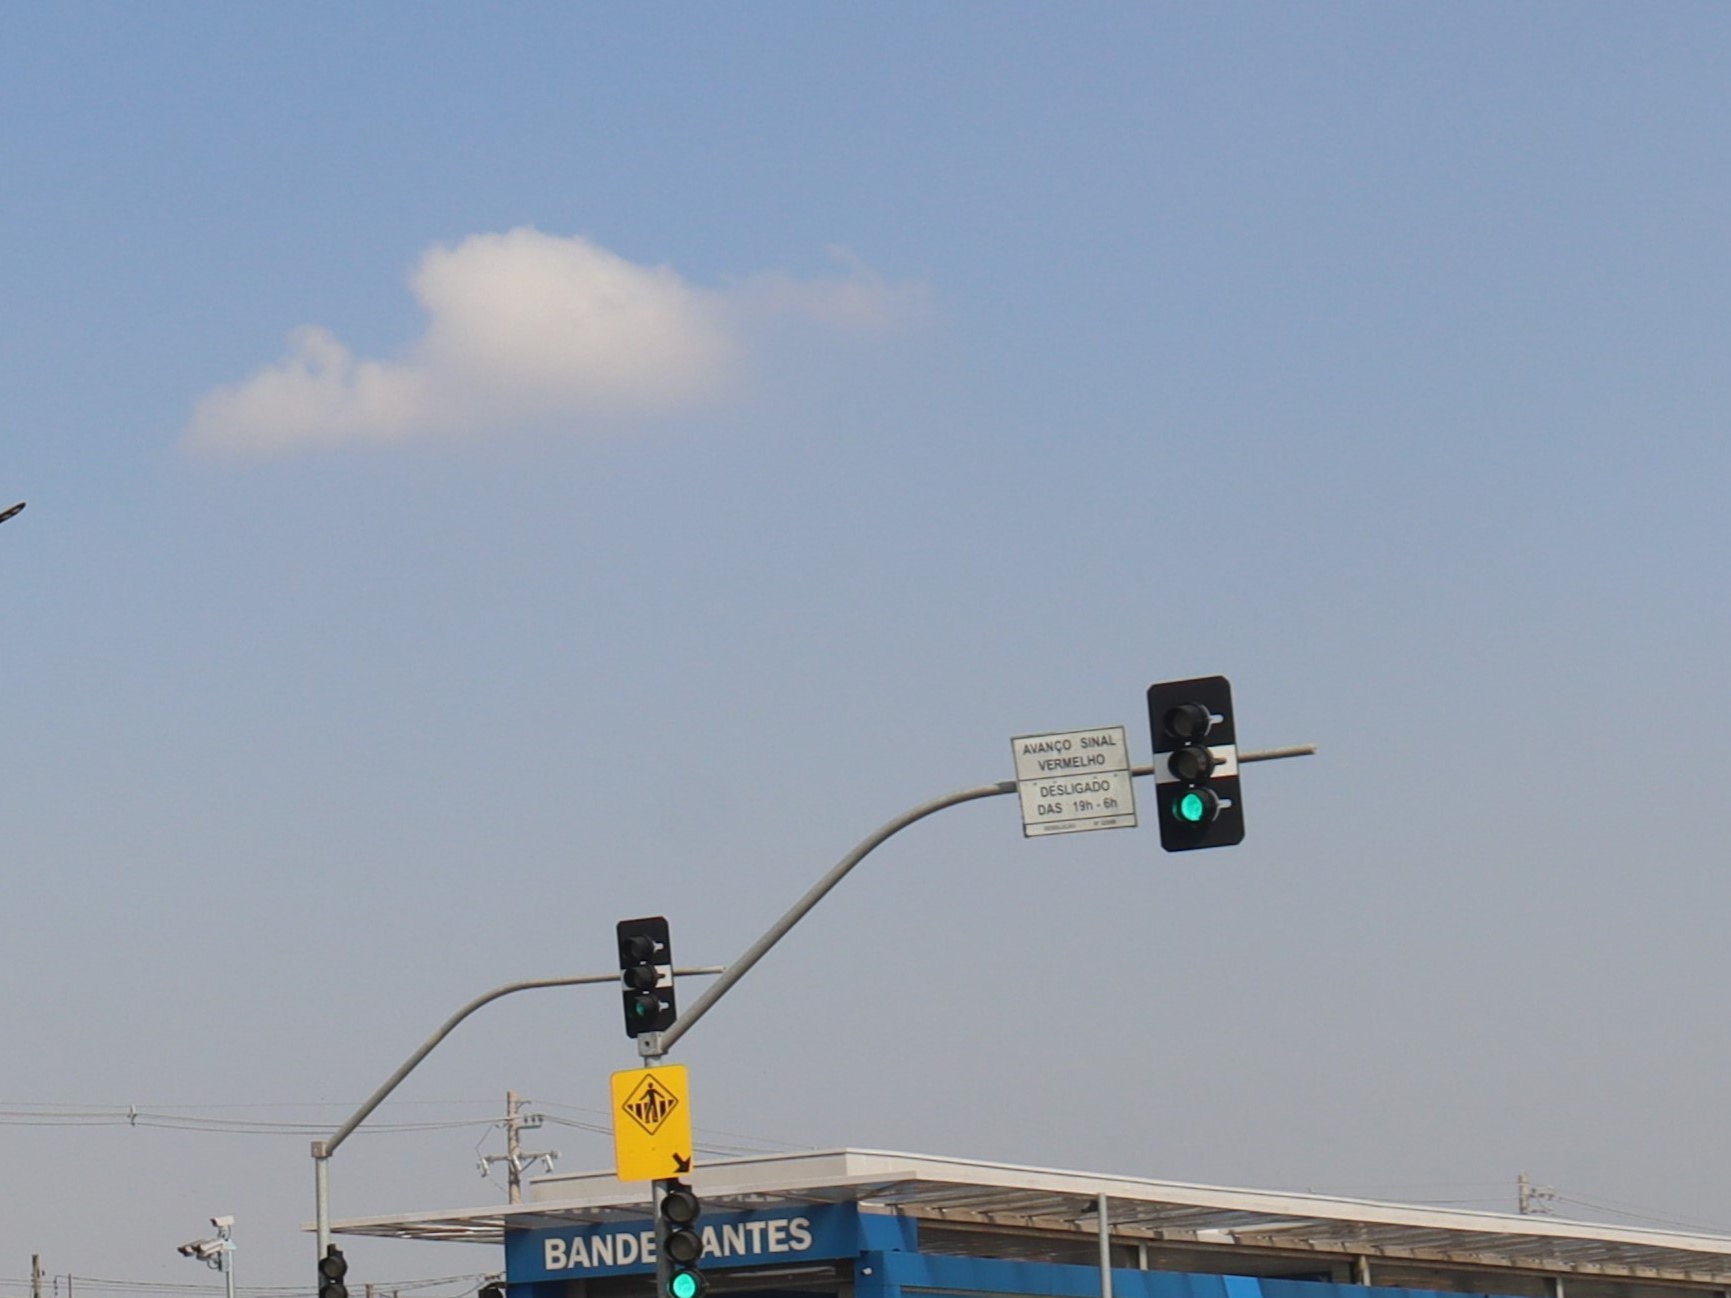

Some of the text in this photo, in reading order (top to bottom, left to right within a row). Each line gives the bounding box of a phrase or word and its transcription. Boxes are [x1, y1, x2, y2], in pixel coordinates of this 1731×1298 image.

[1022, 735, 1117, 755] AVANÇO SINAL
[1038, 753, 1106, 771] VERMELHO
[1040, 780, 1110, 798] DESLIGADO
[1037, 802, 1063, 816] DAS
[1073, 800, 1093, 812] 19h
[1103, 797, 1117, 809] 6h
[544, 1217, 812, 1270] BANDEANTES
